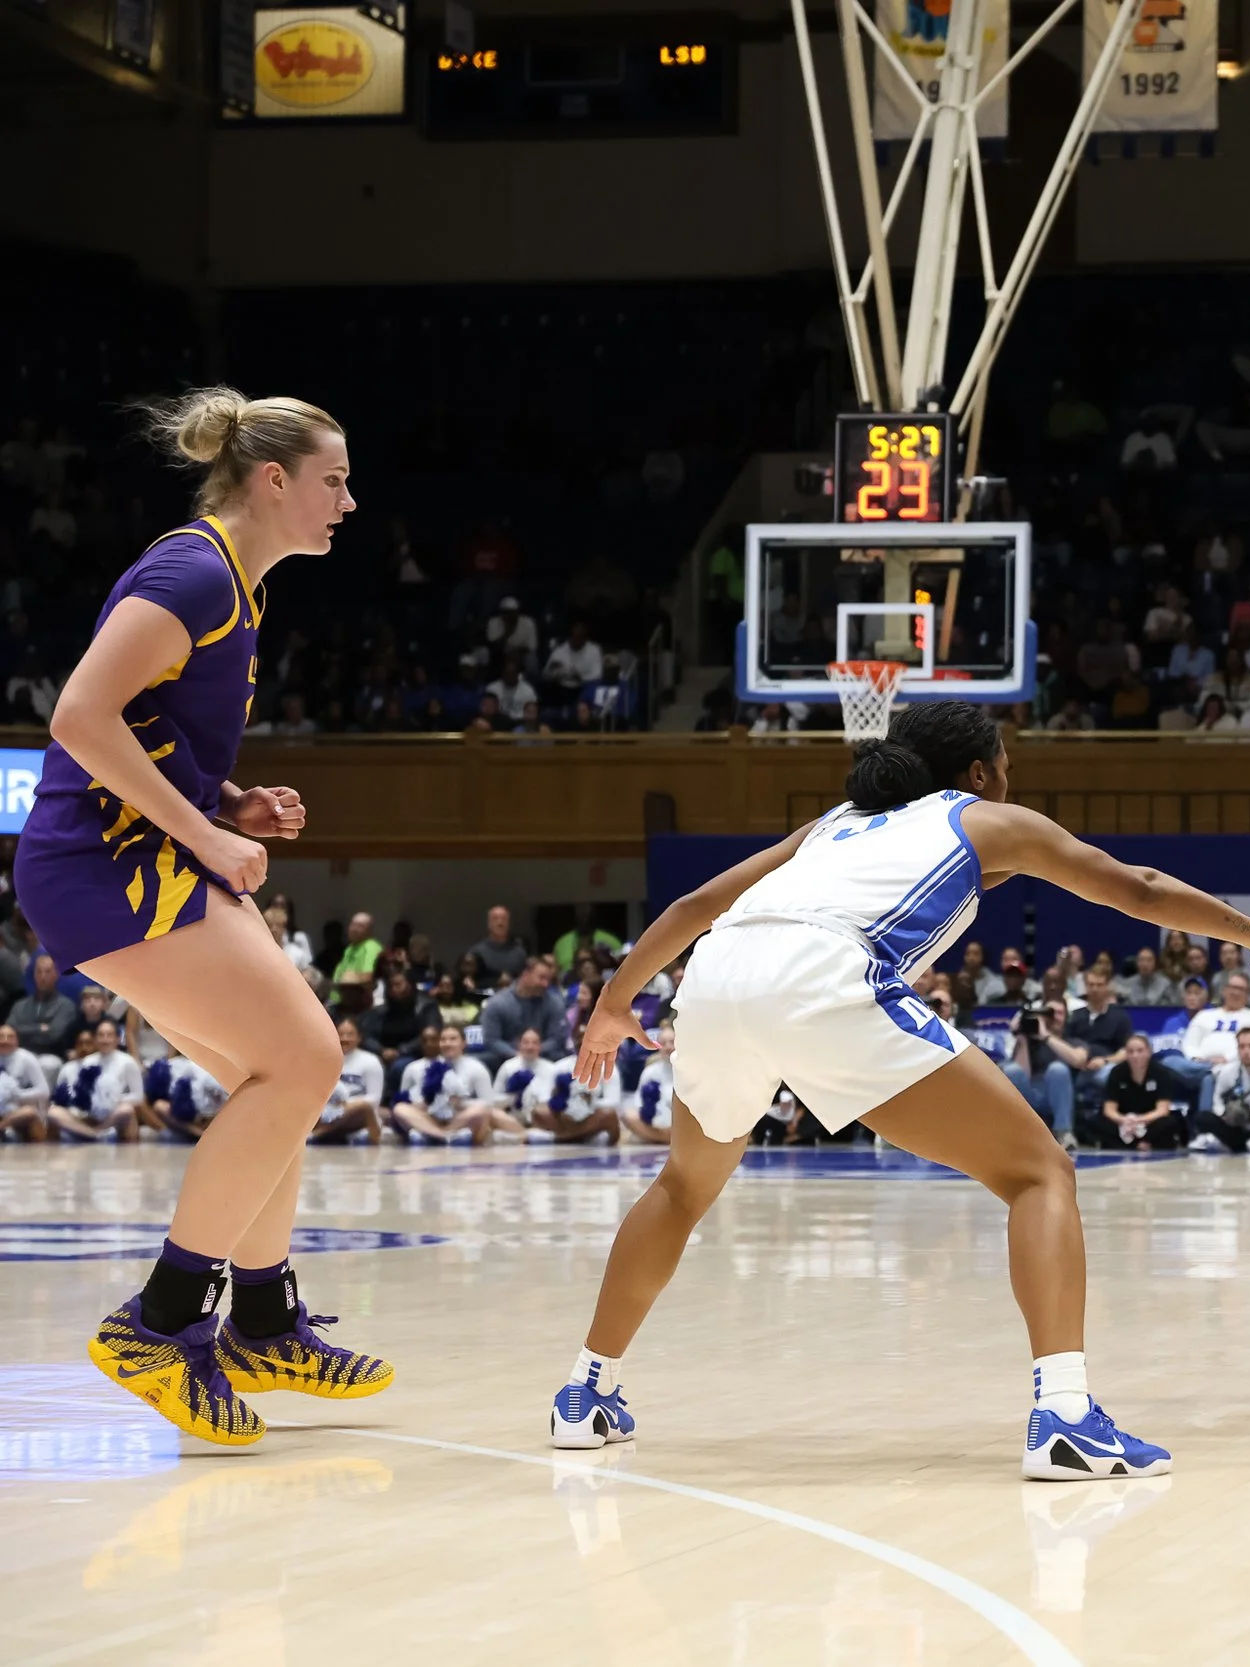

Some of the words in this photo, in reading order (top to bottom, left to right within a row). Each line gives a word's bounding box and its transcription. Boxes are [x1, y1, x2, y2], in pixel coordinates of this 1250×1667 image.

[660, 45, 706, 65] LSU
[1121, 72, 1180, 96] 1992
[869, 425, 940, 460] 5:27
[858, 461, 929, 518] 23
